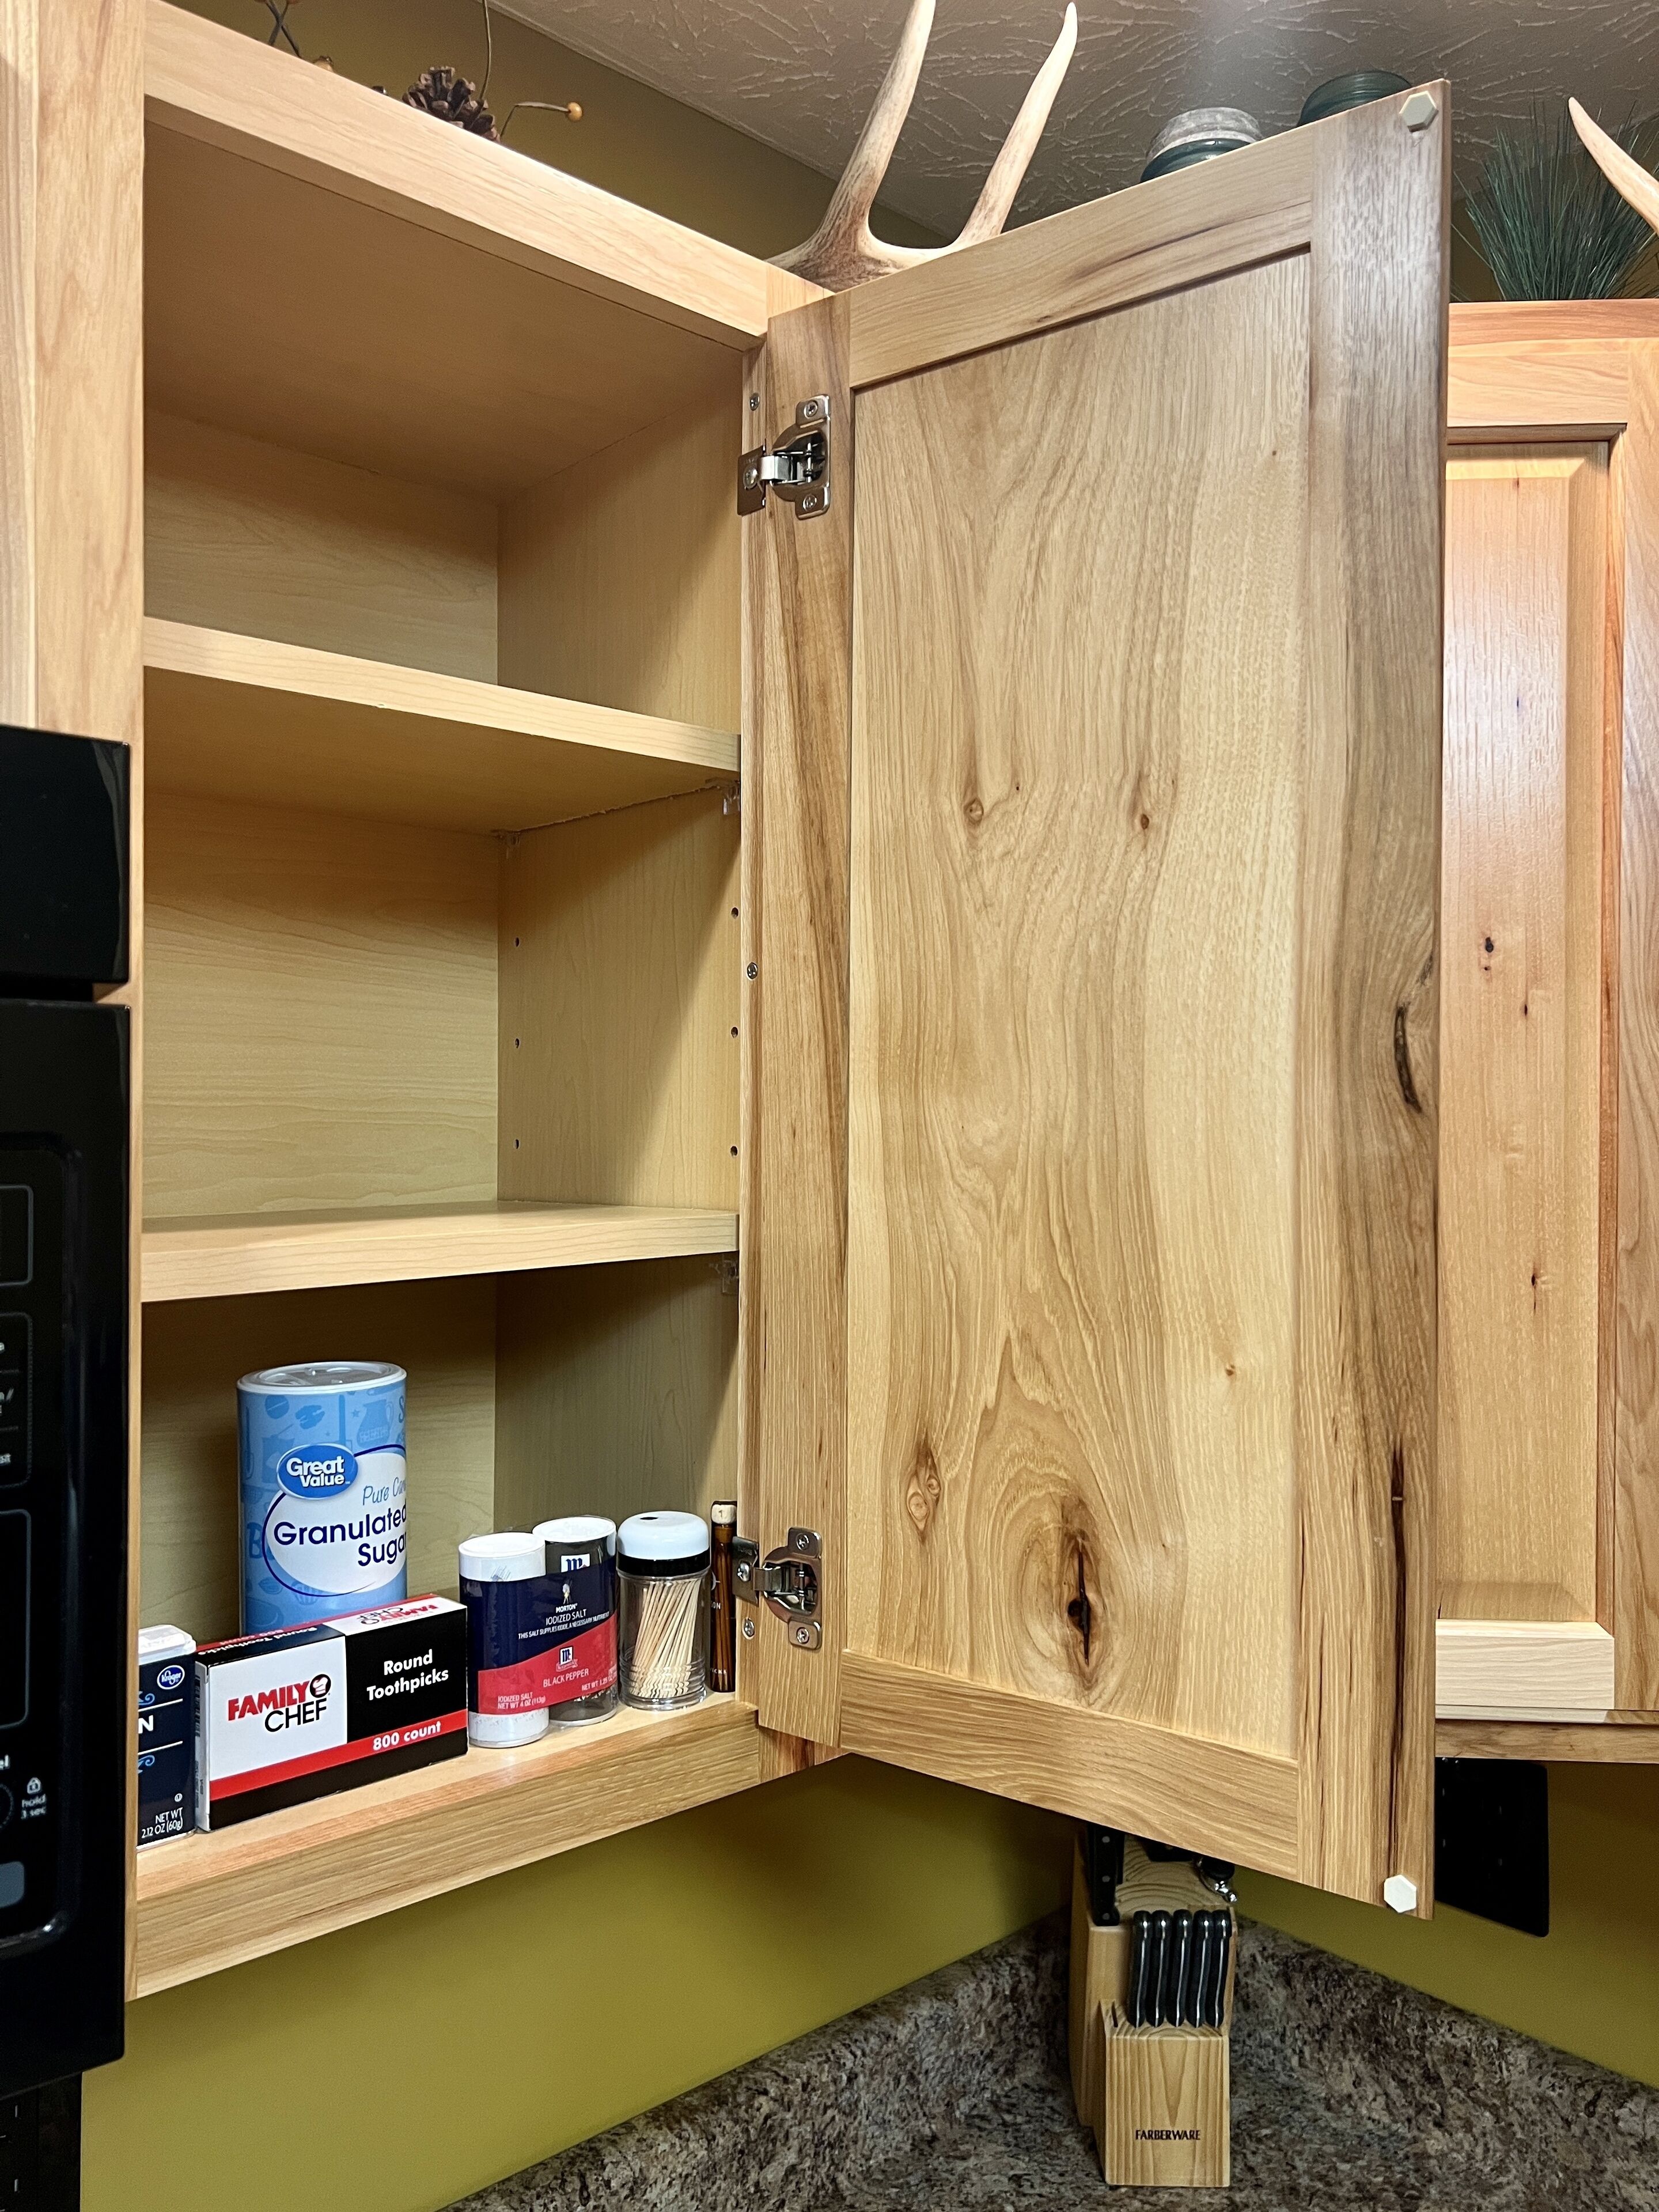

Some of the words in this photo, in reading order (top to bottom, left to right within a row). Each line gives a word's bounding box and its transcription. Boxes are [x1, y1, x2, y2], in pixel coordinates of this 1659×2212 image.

[286, 1456, 344, 1476] Great
[300, 1474, 345, 1487] Value
[363, 1485, 389, 1506] Pure
[546, 1613, 570, 1626] IODIZED
[572, 1609, 587, 1620] SALT
[518, 1632, 529, 1640] THIS
[529, 1629, 539, 1638] SALT
[539, 1626, 558, 1636] SUPPLIES
[384, 1649, 433, 1675] Round
[161, 1670, 181, 1685] Kroger
[366, 1668, 449, 1700] Toothpicks
[543, 1677, 565, 1688] BLACK
[566, 1668, 589, 1680] PEPPER
[581, 1683, 591, 1691] NET
[591, 1680, 599, 1688] WT
[228, 1680, 310, 1721] FAMILY
[498, 1695, 520, 1703] IODIZED
[521, 1691, 533, 1699] SALT
[264, 1697, 327, 1732] CHEF
[498, 1702, 509, 1710] NET
[373, 1732, 400, 1751] 800
[404, 1721, 441, 1742] count
[156, 1811, 170, 1824] NET
[171, 1807, 183, 1819] WT
[154, 1823, 165, 1835] OZ
[1135, 2130, 1200, 2140] FARBERWARE
